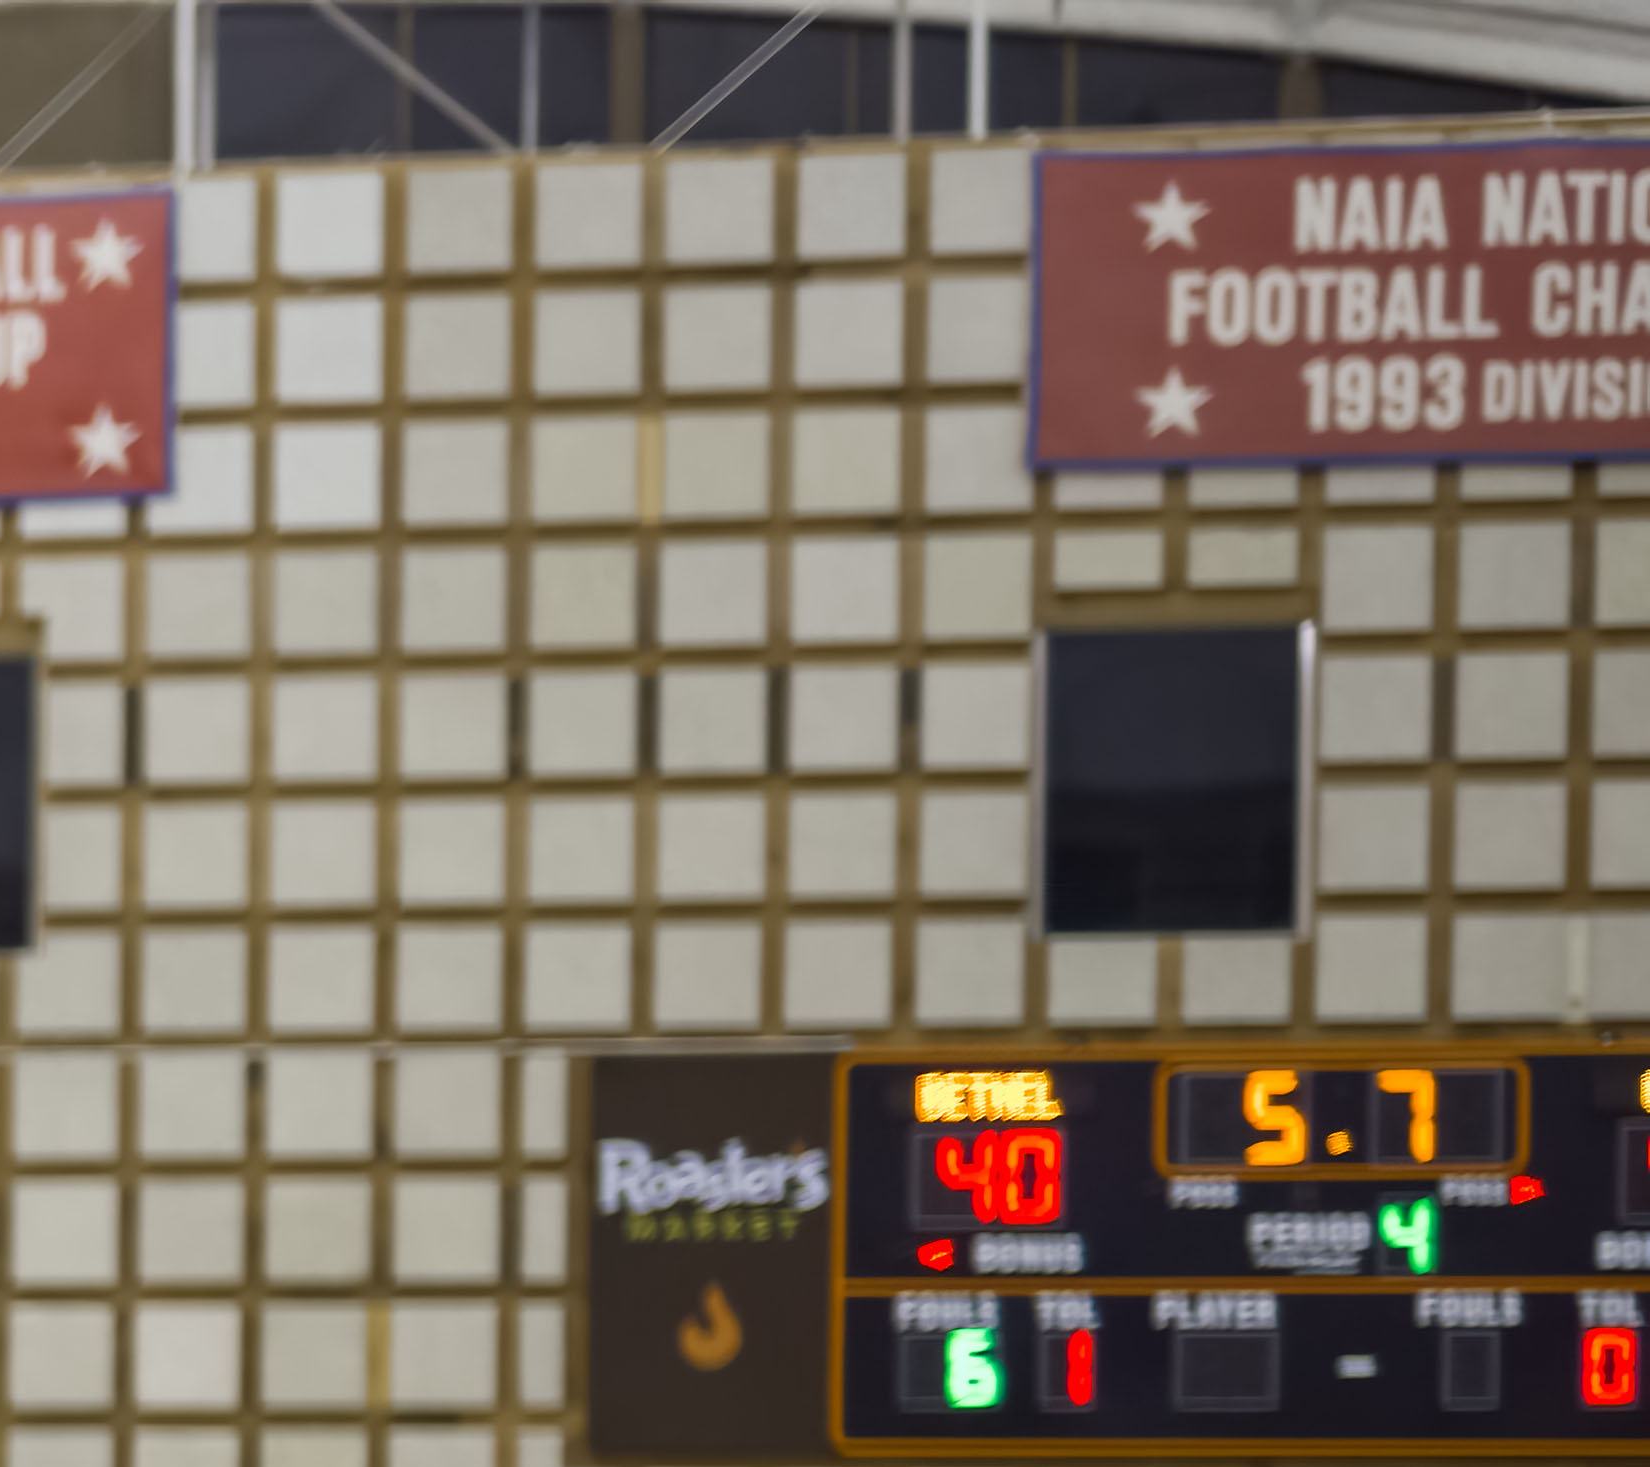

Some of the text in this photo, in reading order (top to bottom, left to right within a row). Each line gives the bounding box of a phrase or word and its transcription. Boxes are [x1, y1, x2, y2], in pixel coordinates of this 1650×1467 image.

[1294, 174, 1450, 253] NAIA
[1168, 263, 1500, 346] FOOTBALL
[1303, 354, 1465, 432] 1993
[935, 1128, 1060, 1224] 40
[1248, 1198, 1438, 1275] PERIOD 4
[895, 1291, 998, 1331] FOULS
[1154, 1291, 1276, 1330] PLAYER
[1416, 1290, 1521, 1327] FOULS
[945, 1328, 1005, 1408] 6
[1582, 1328, 1636, 1405] 0
